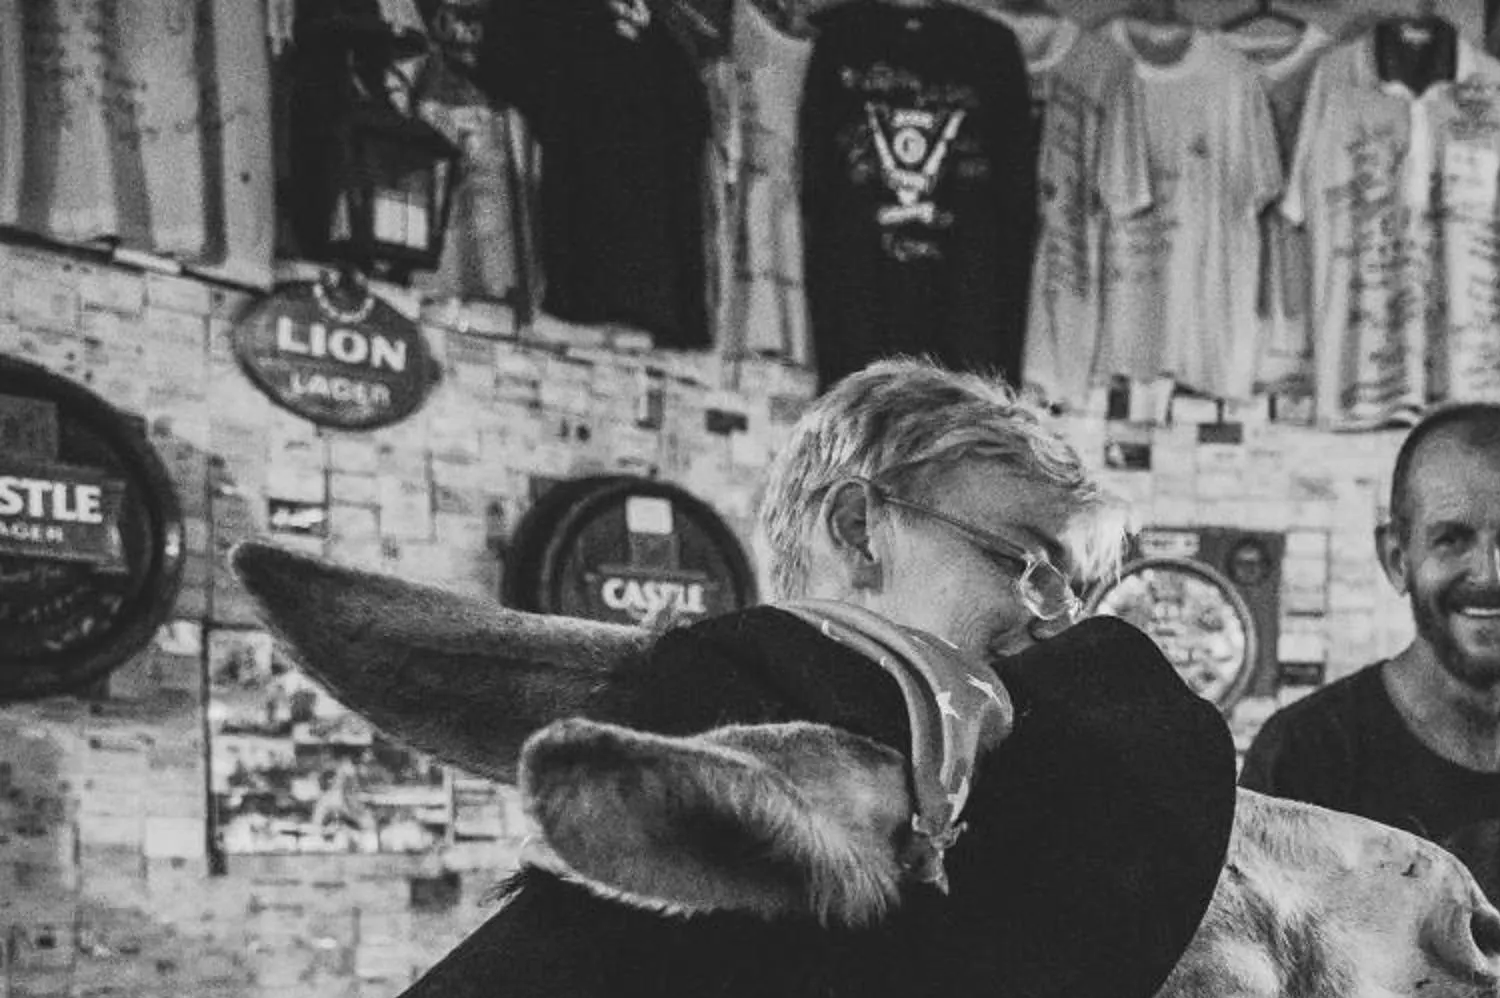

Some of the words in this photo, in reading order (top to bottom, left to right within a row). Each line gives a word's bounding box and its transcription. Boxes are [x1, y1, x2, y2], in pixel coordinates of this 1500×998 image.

[277, 315, 406, 372] LION
[289, 373, 391, 407] LAGER
[602, 577, 707, 614] CASTLE
